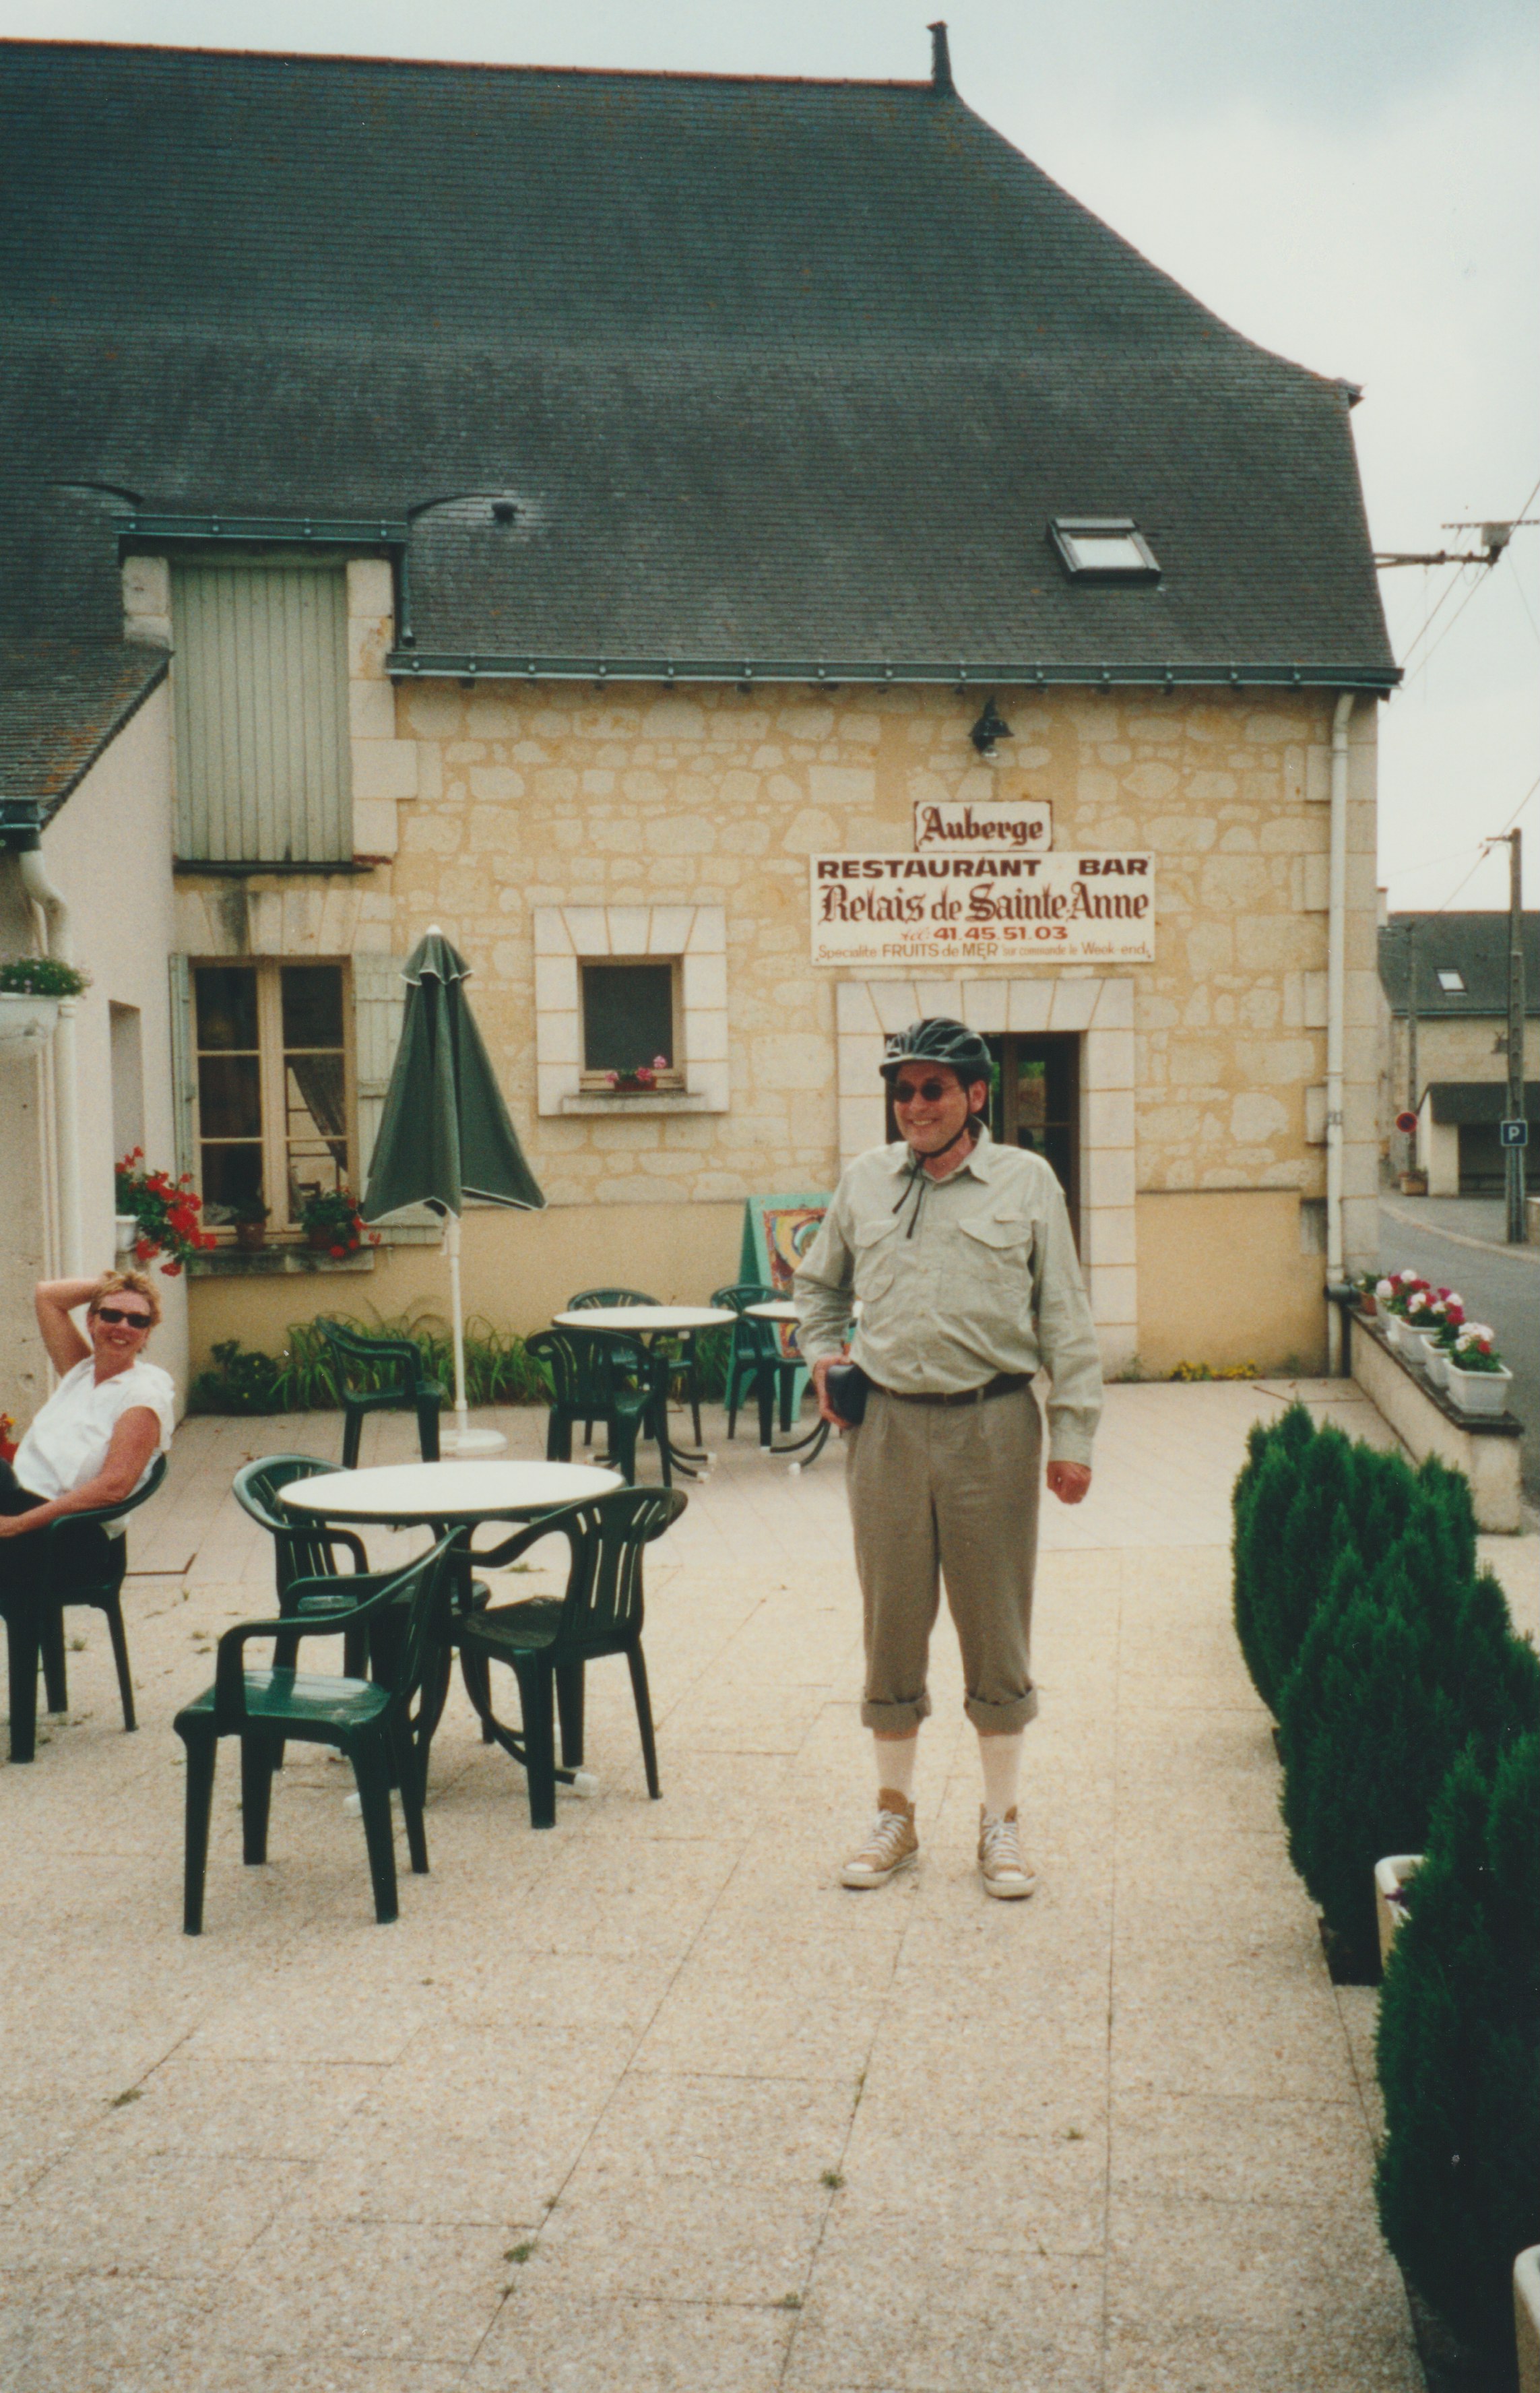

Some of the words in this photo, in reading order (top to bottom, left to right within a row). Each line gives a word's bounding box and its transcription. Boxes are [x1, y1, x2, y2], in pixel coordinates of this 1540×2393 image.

[918, 805, 1044, 846] Auberge
[817, 858, 1041, 879] RESTAURANT
[1079, 858, 1149, 876] BAR
[818, 883, 926, 925] Relais
[930, 884, 963, 922] de
[933, 926, 1068, 940] 41.45.51.03
[882, 943, 939, 957] FRUITS
[942, 944, 959, 957] de
[962, 941, 999, 957] MER
[1508, 1126, 1520, 1141] P
